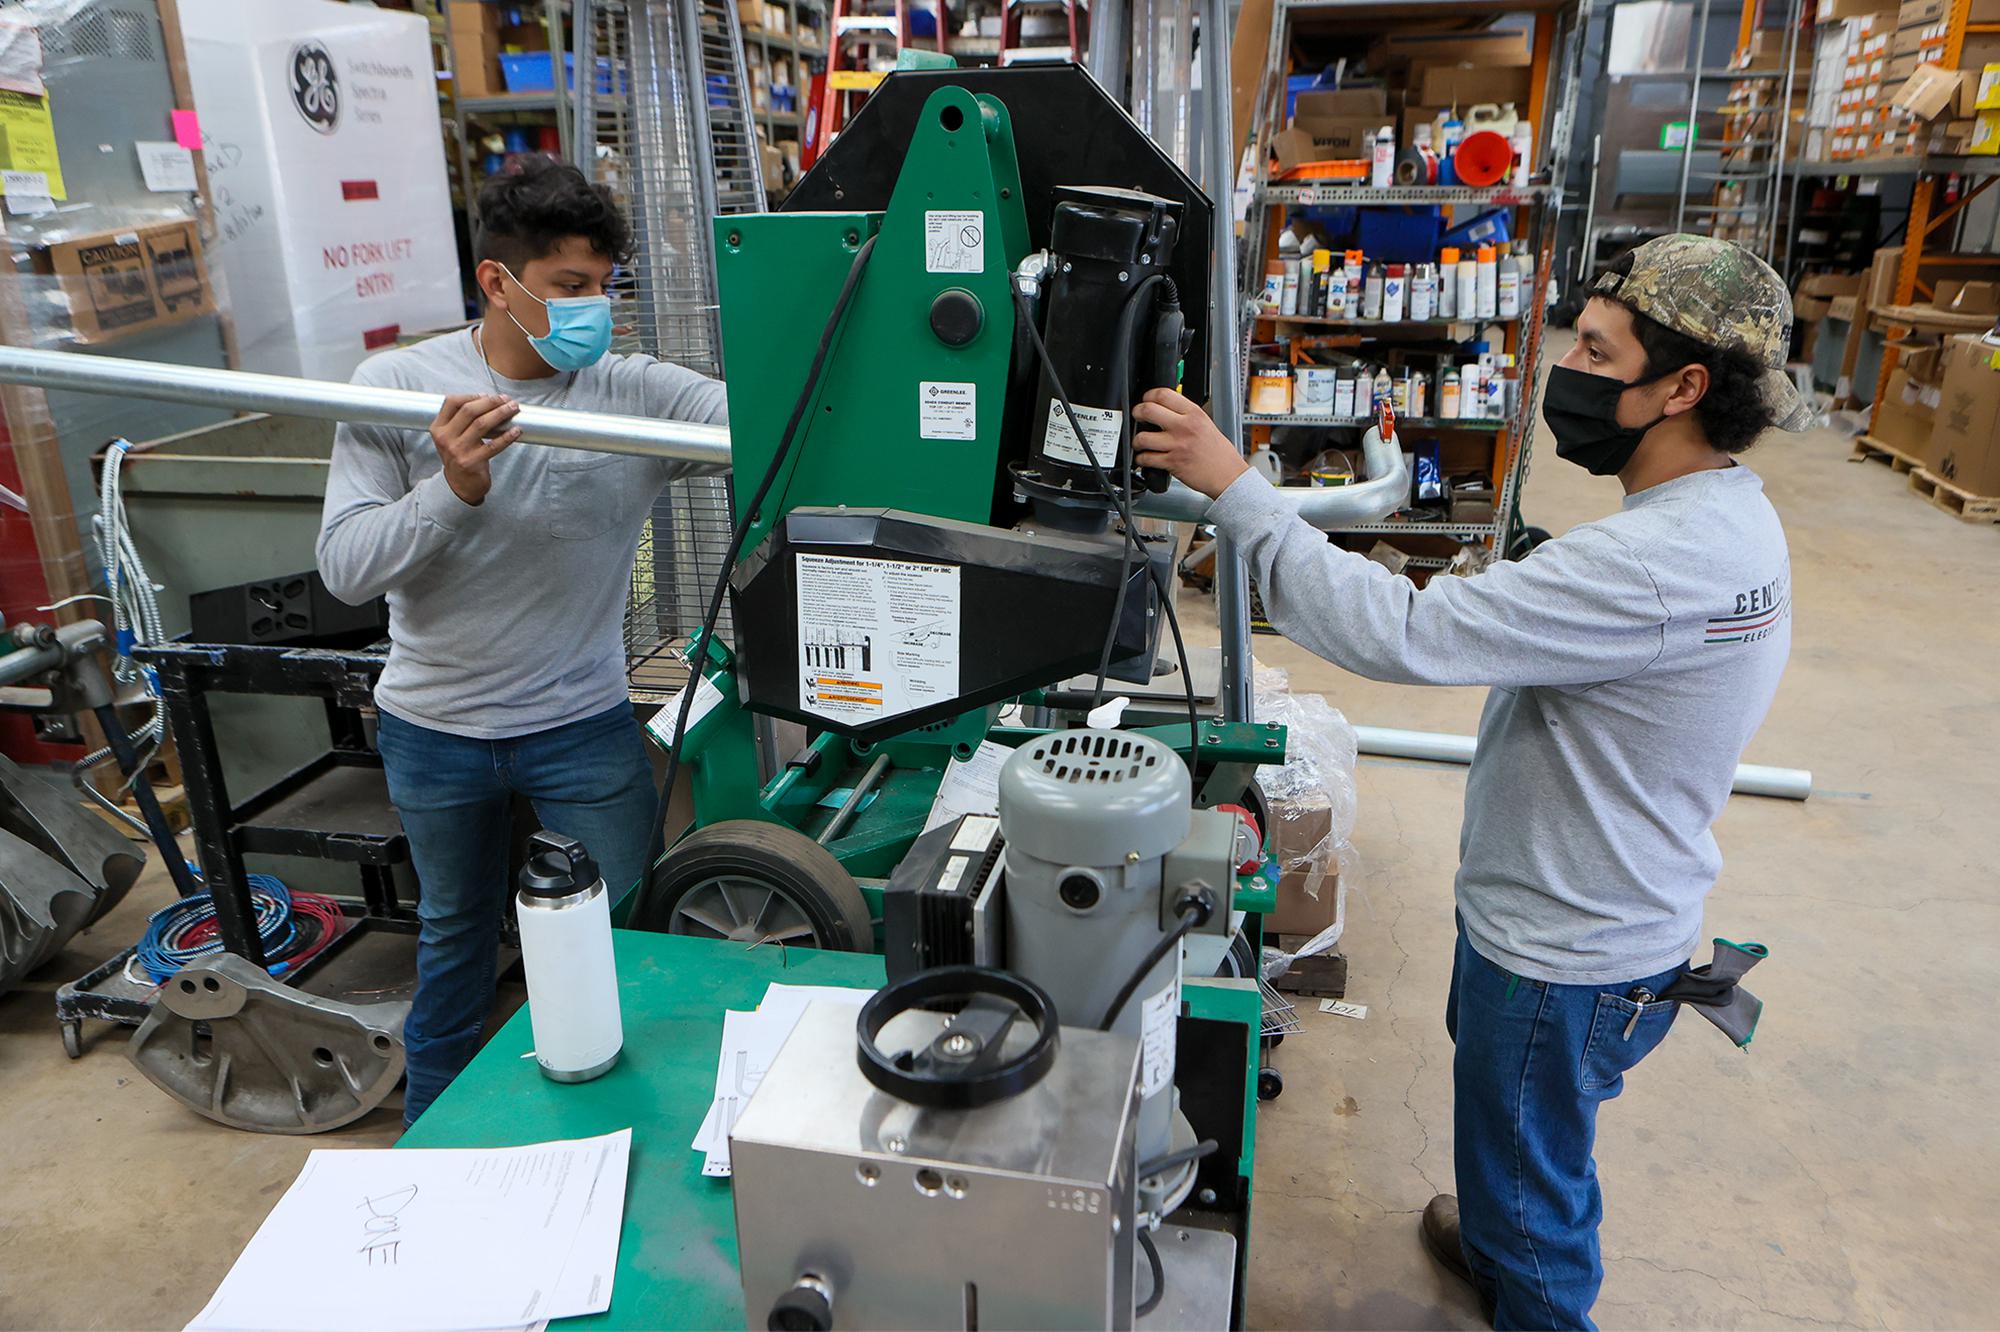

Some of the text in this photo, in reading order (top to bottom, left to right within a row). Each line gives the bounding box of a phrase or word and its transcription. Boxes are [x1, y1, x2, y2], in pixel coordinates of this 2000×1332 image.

[82, 243, 140, 265] CAUTION
[322, 243, 350, 270] NO
[351, 240, 385, 266] FORK
[356, 271, 396, 298] ENTRY
[356, 1183, 418, 1266] DONE
